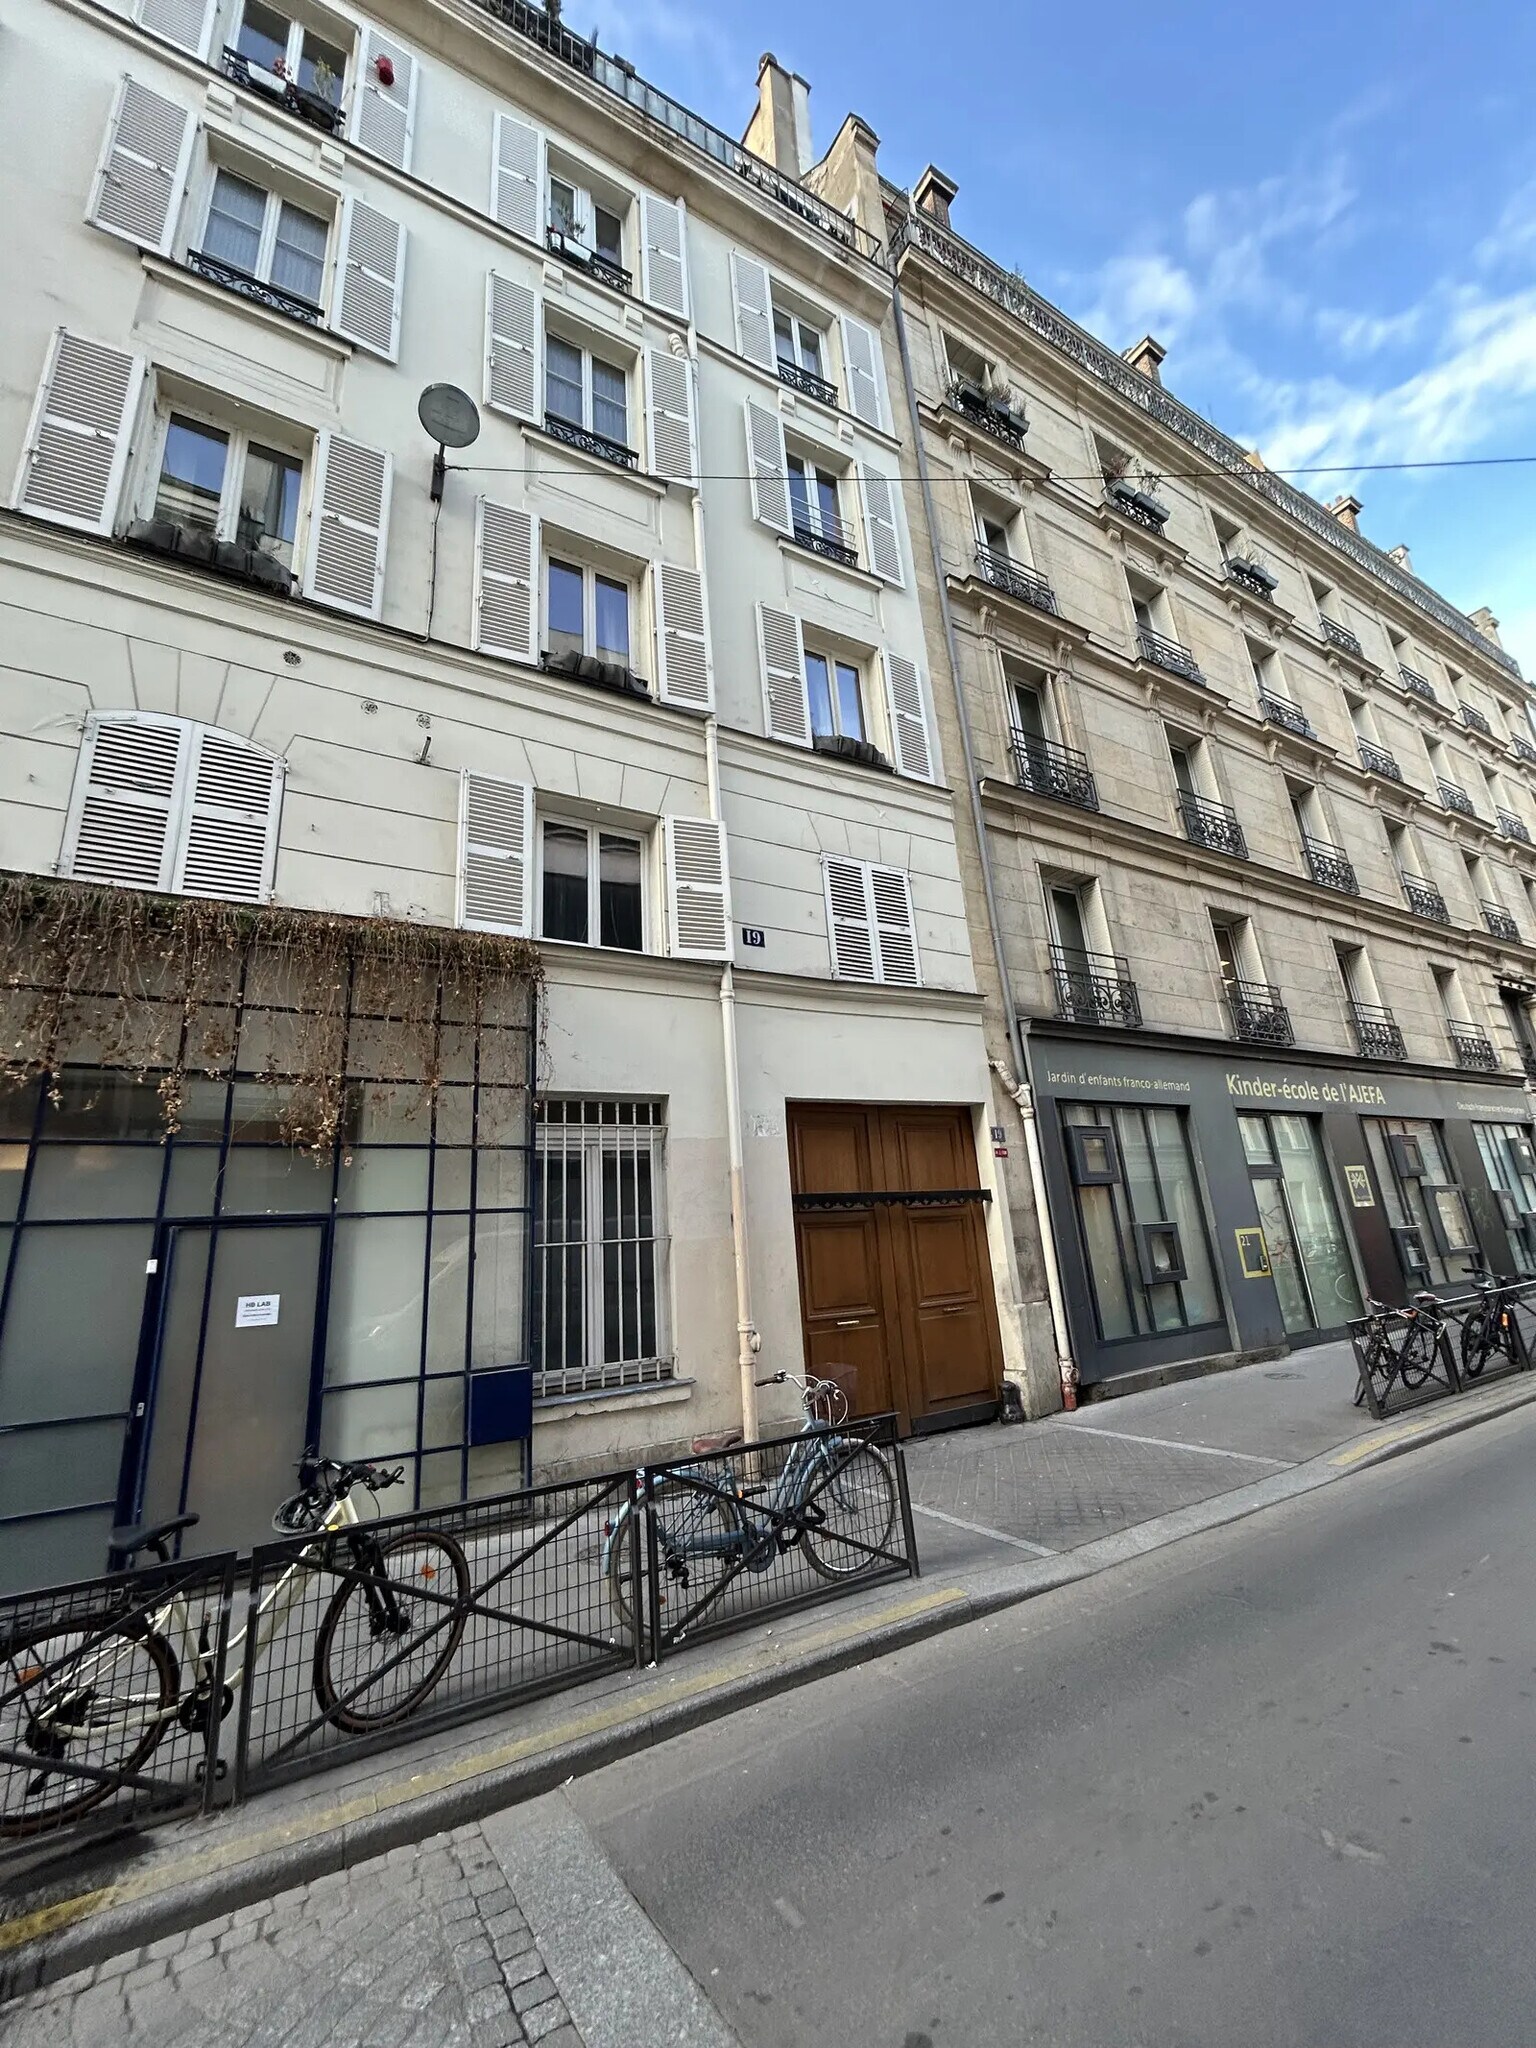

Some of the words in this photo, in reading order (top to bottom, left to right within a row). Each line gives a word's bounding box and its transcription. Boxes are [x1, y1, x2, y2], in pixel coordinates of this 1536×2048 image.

[746, 930, 761, 945] 19
[1047, 1071, 1077, 1084] Jardin
[1123, 1076, 1191, 1092] franco-allemand
[1225, 1073, 1320, 1100] Kinder-école
[1321, 1082, 1340, 1102] de
[1340, 1083, 1386, 1105] l'AJEFA
[994, 1129, 1003, 1139] 19
[1240, 1235, 1251, 1246] 21
